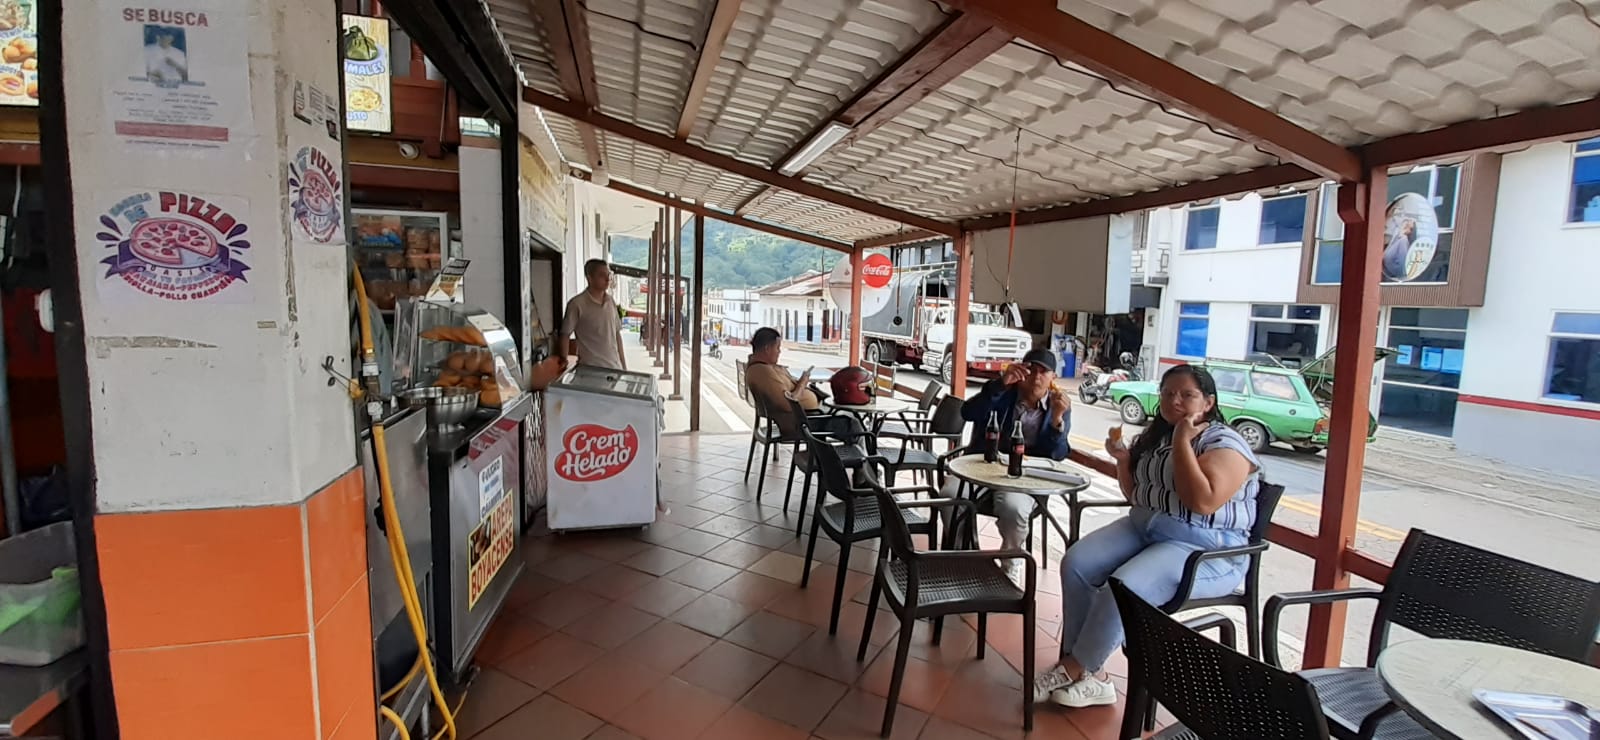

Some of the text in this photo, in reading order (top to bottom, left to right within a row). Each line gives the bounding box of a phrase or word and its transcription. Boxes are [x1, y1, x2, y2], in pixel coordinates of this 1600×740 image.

[123, 8, 208, 27] SE BUSCA
[159, 191, 236, 235] PIZZA
[570, 431, 625, 454] Crem
[562, 446, 631, 478] Helado
[491, 492, 513, 540] AREPA
[471, 521, 513, 603] BOYACENSE
